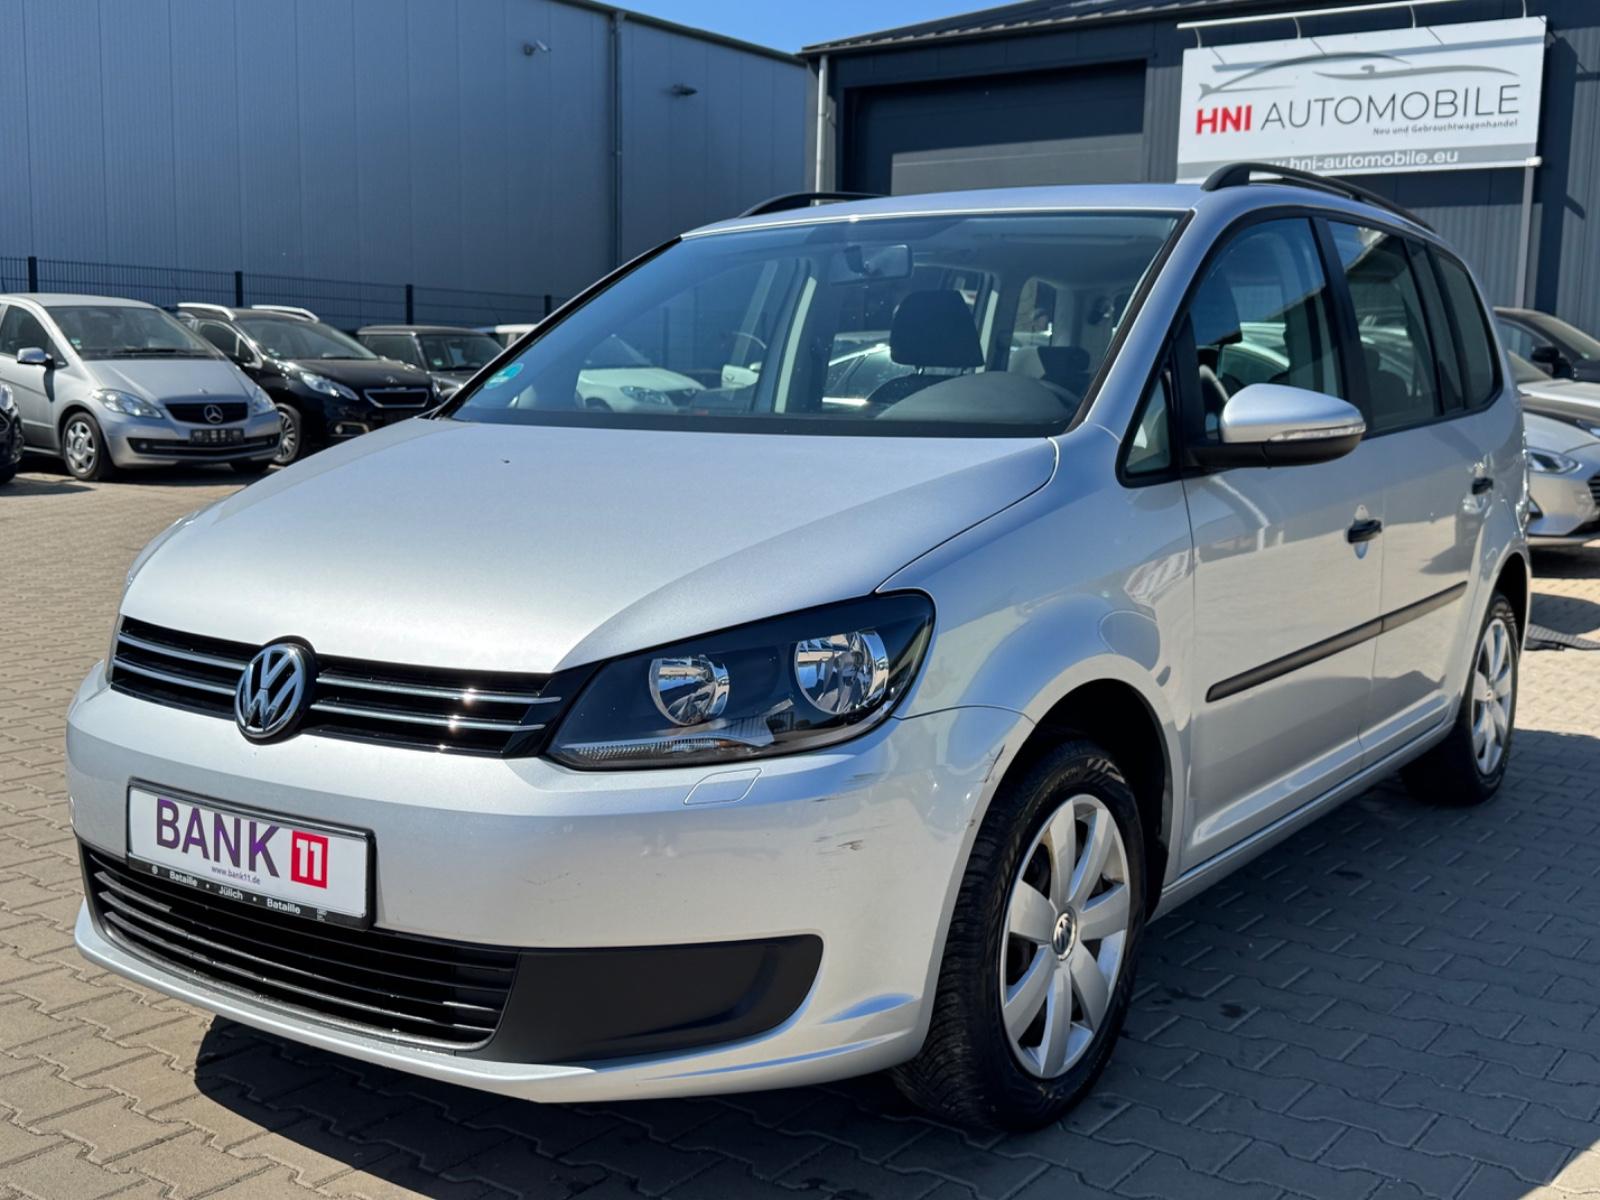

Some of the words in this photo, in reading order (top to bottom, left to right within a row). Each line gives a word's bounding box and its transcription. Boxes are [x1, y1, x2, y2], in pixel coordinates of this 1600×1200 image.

[1196, 105, 1252, 135] HNI
[1261, 84, 1521, 131] AUTOMOBILE
[1373, 127, 1390, 135] Neu
[1392, 125, 1409, 134] und
[1411, 119, 1518, 133] Gebrauchtwagenhandel
[156, 798, 280, 877] BANK
[293, 834, 326, 885] 11
[218, 886, 243, 900] Jülich
